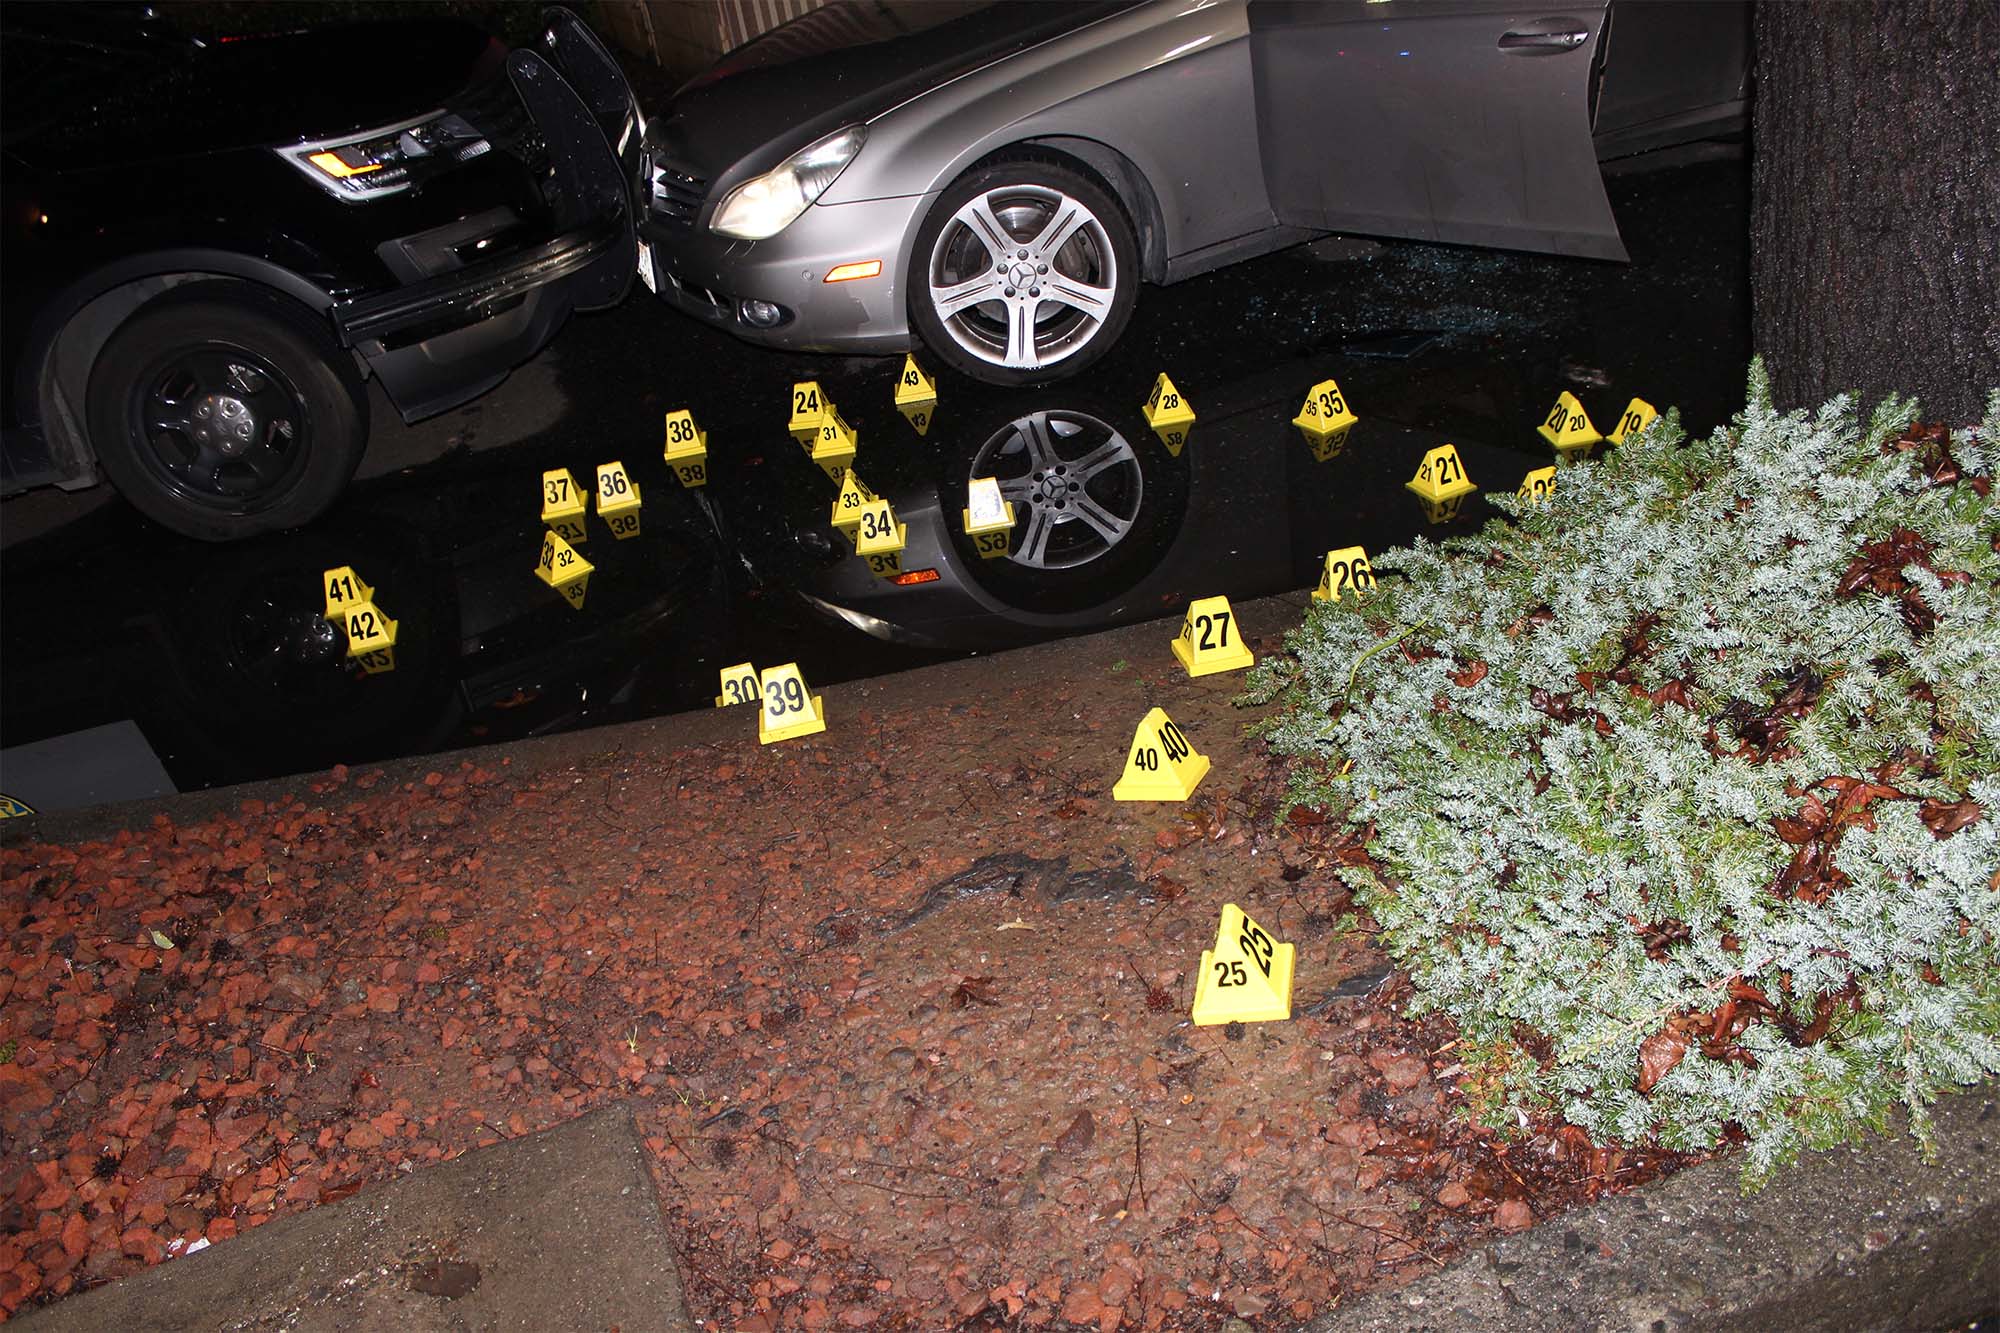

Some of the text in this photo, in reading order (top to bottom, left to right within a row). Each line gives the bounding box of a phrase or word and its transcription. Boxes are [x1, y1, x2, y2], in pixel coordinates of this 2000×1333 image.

[905, 371, 918, 386] 43
[795, 390, 818, 414] 24
[1163, 394, 1178, 409] 28
[1306, 400, 1317, 416] 35
[1320, 389, 1343, 418] 35
[669, 419, 693, 443] 38
[1548, 403, 1568, 433] 20
[1570, 415, 1585, 432] 20
[1621, 411, 1641, 436] 19
[823, 426, 837, 440] 31
[1420, 464, 1431, 482] 21
[1436, 453, 1461, 485] 21
[545, 478, 568, 504] 37
[600, 471, 626, 497] 36
[843, 492, 859, 508] 33
[862, 510, 891, 539] 34
[557, 549, 574, 567] 32
[330, 576, 354, 602] 41
[1333, 558, 1370, 596] 26
[350, 612, 379, 640] 42
[1196, 612, 1230, 650] 27
[725, 676, 760, 705] 30
[766, 677, 804, 716] 39
[1158, 721, 1188, 763] 40
[1135, 748, 1158, 771] 40
[1240, 915, 1273, 978] 25
[1214, 961, 1247, 987] 25
